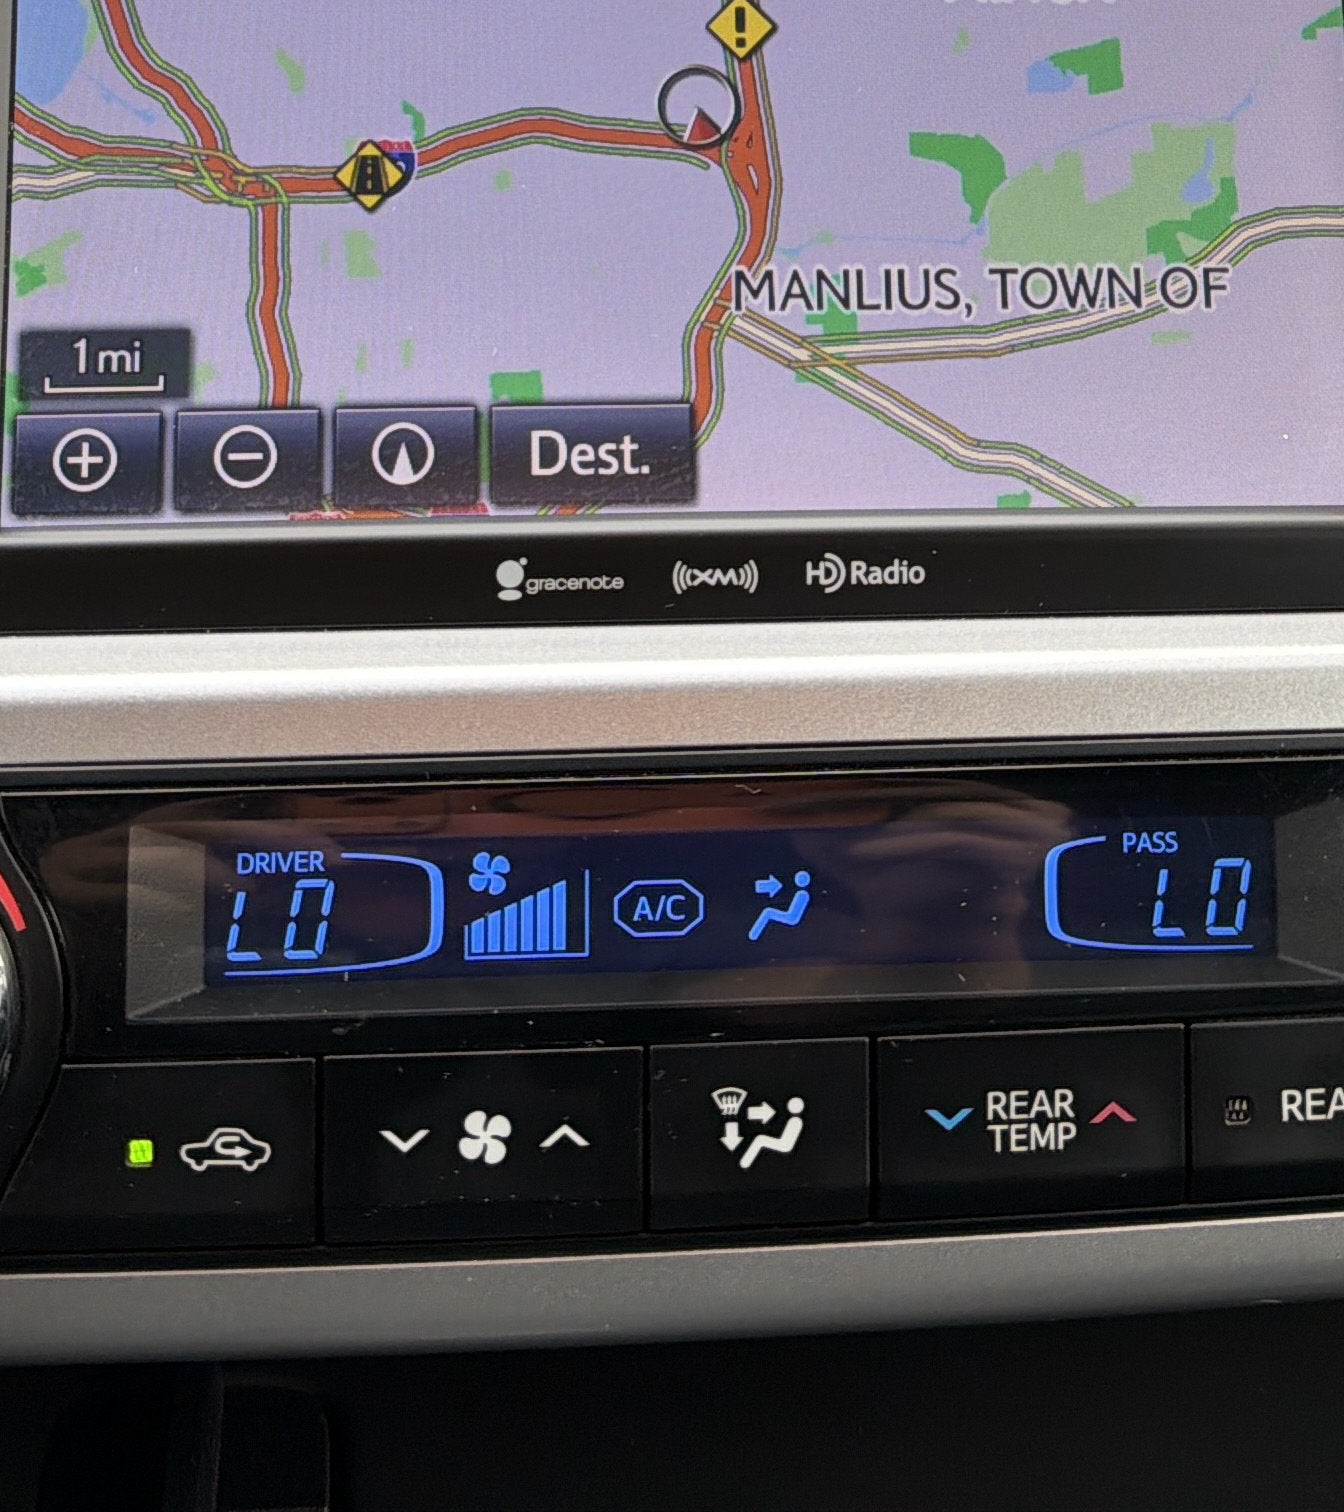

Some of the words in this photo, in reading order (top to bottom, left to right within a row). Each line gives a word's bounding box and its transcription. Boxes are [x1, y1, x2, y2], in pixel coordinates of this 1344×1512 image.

[731, 267, 975, 320] MANLIUS,
[997, 267, 1137, 312] TOWN
[1158, 265, 1231, 309] OF
[98, 340, 141, 373] mi
[530, 429, 650, 476] Dest.
[525, 572, 625, 595] gracenote
[850, 558, 926, 586] Radio
[1122, 831, 1179, 854] PASS
[237, 850, 325, 875] DRIVER
[632, 894, 686, 922] A/C
[986, 1089, 1075, 1119] REAR
[987, 1122, 1077, 1153] TEMP
